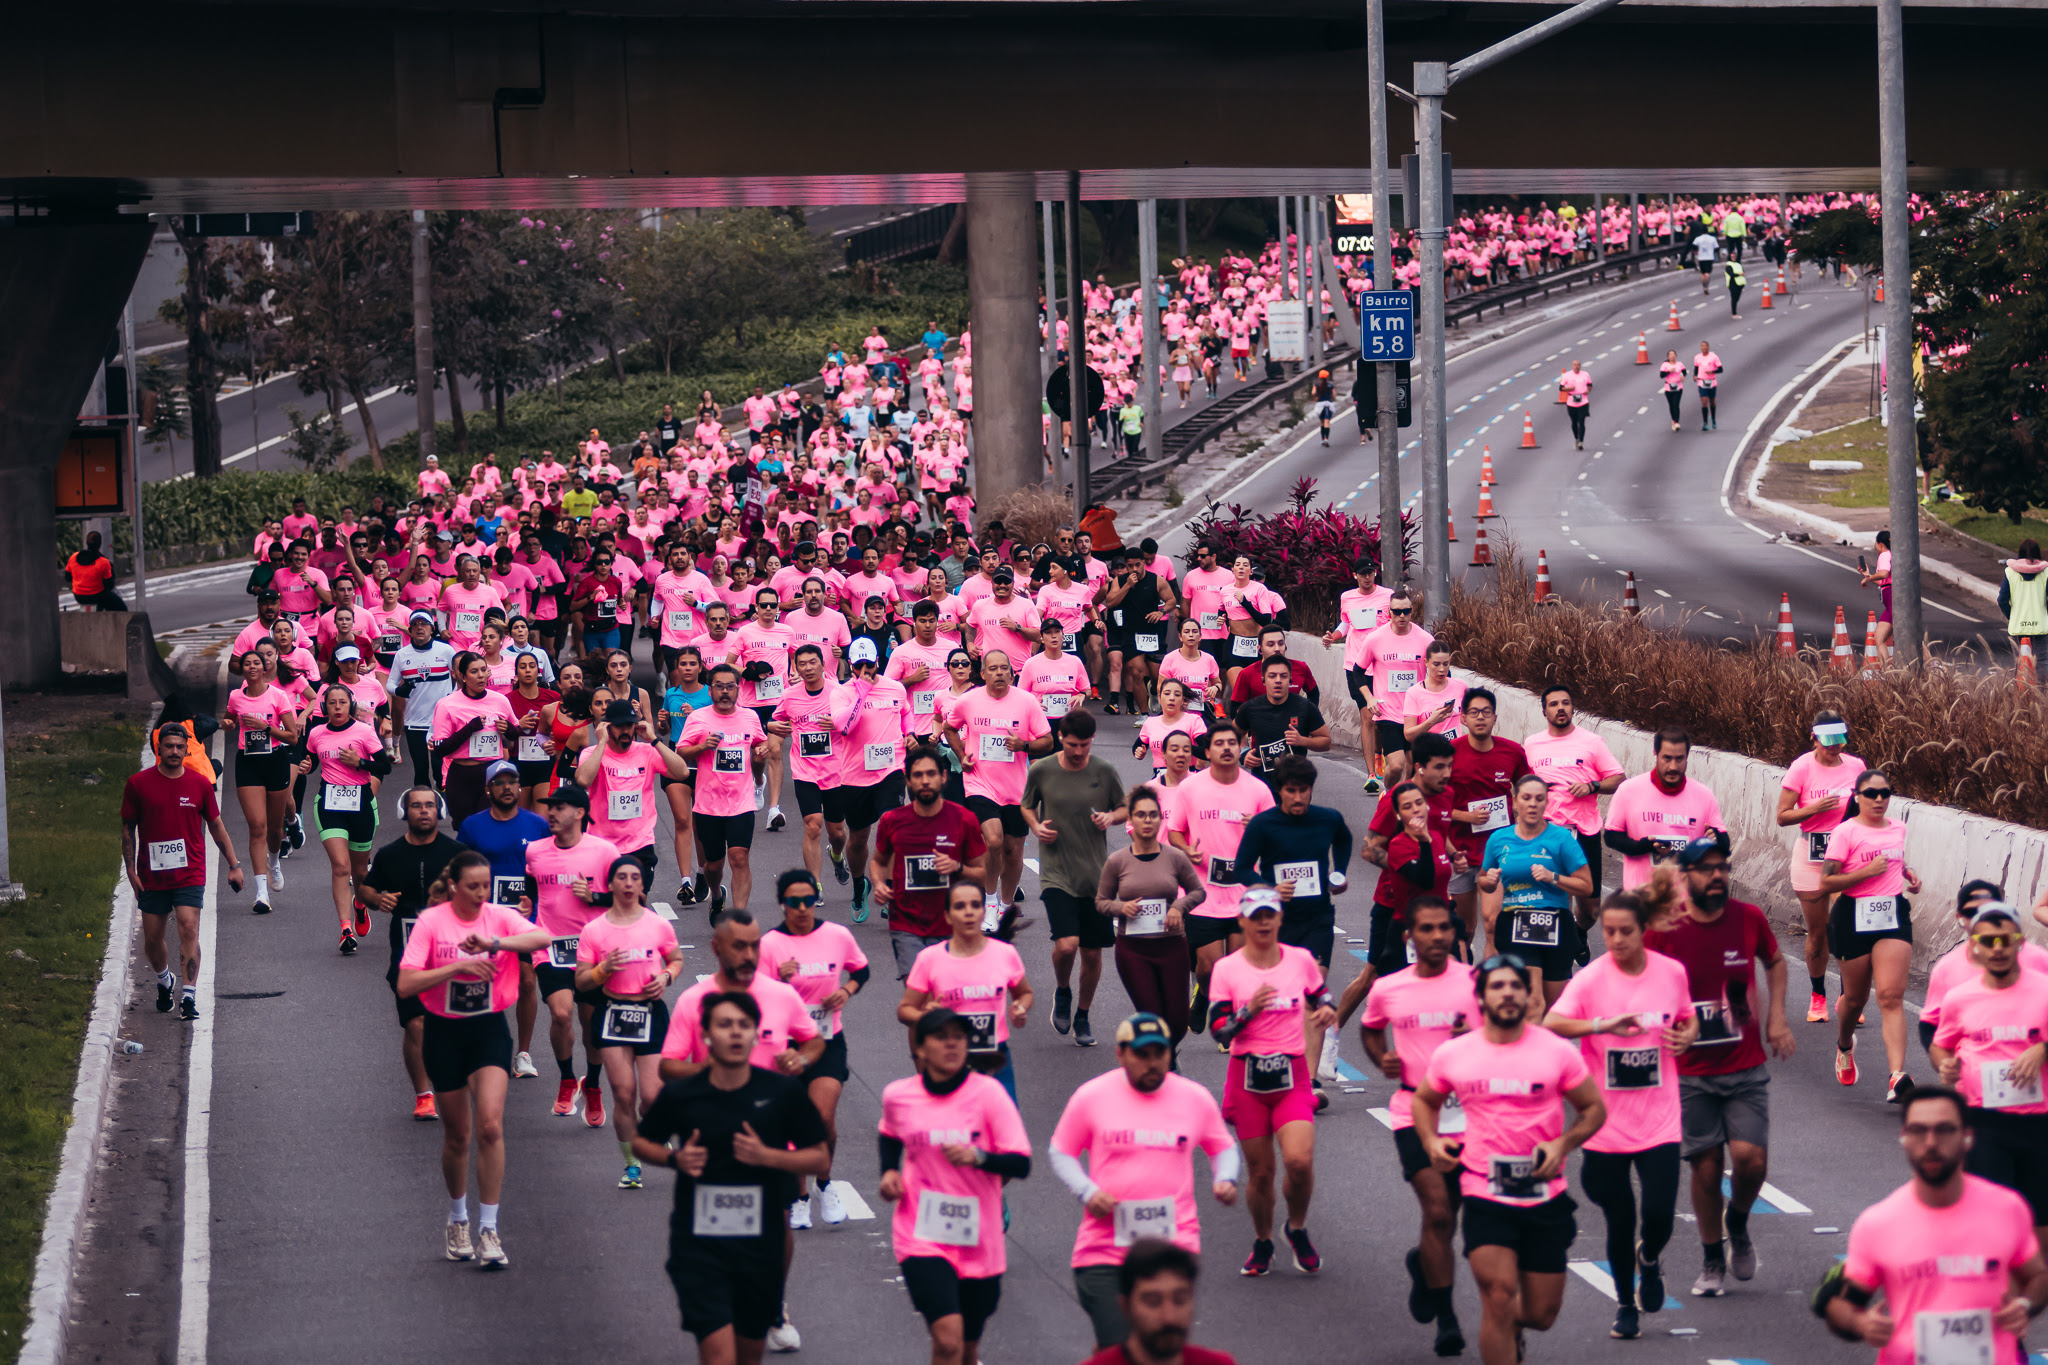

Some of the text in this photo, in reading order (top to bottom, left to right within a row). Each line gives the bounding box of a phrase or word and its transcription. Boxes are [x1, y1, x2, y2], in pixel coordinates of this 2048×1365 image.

[1366, 296, 1408, 306] Bairro
[1370, 314, 1405, 331] km
[1372, 336, 1404, 355] 5,8
[463, 614, 479, 622] 7006
[2020, 619, 2039, 628] STAFF
[1240, 639, 1257, 647] 6970
[1397, 673, 1414, 681] 6333
[1052, 697, 1068, 705] 5413
[973, 717, 1012, 728] LIVE!RUN
[250, 732, 267, 740] 665
[480, 735, 497, 743] 5780
[807, 733, 827, 743] 1647
[874, 747, 893, 757] 5569
[1269, 743, 1286, 754] 455
[724, 751, 741, 760] 1364
[336, 789, 357, 798] 5200
[620, 794, 639, 804] 8247
[1486, 800, 1504, 812] 255
[1643, 811, 1688, 826] LIVE!RUN
[158, 842, 184, 854] 7266
[1284, 867, 1313, 879] 10581
[1869, 901, 1892, 913] 5957
[1529, 913, 1553, 926] 868
[465, 983, 486, 996] 265
[620, 1010, 645, 1023] 4281
[1620, 1051, 1658, 1067] 4082
